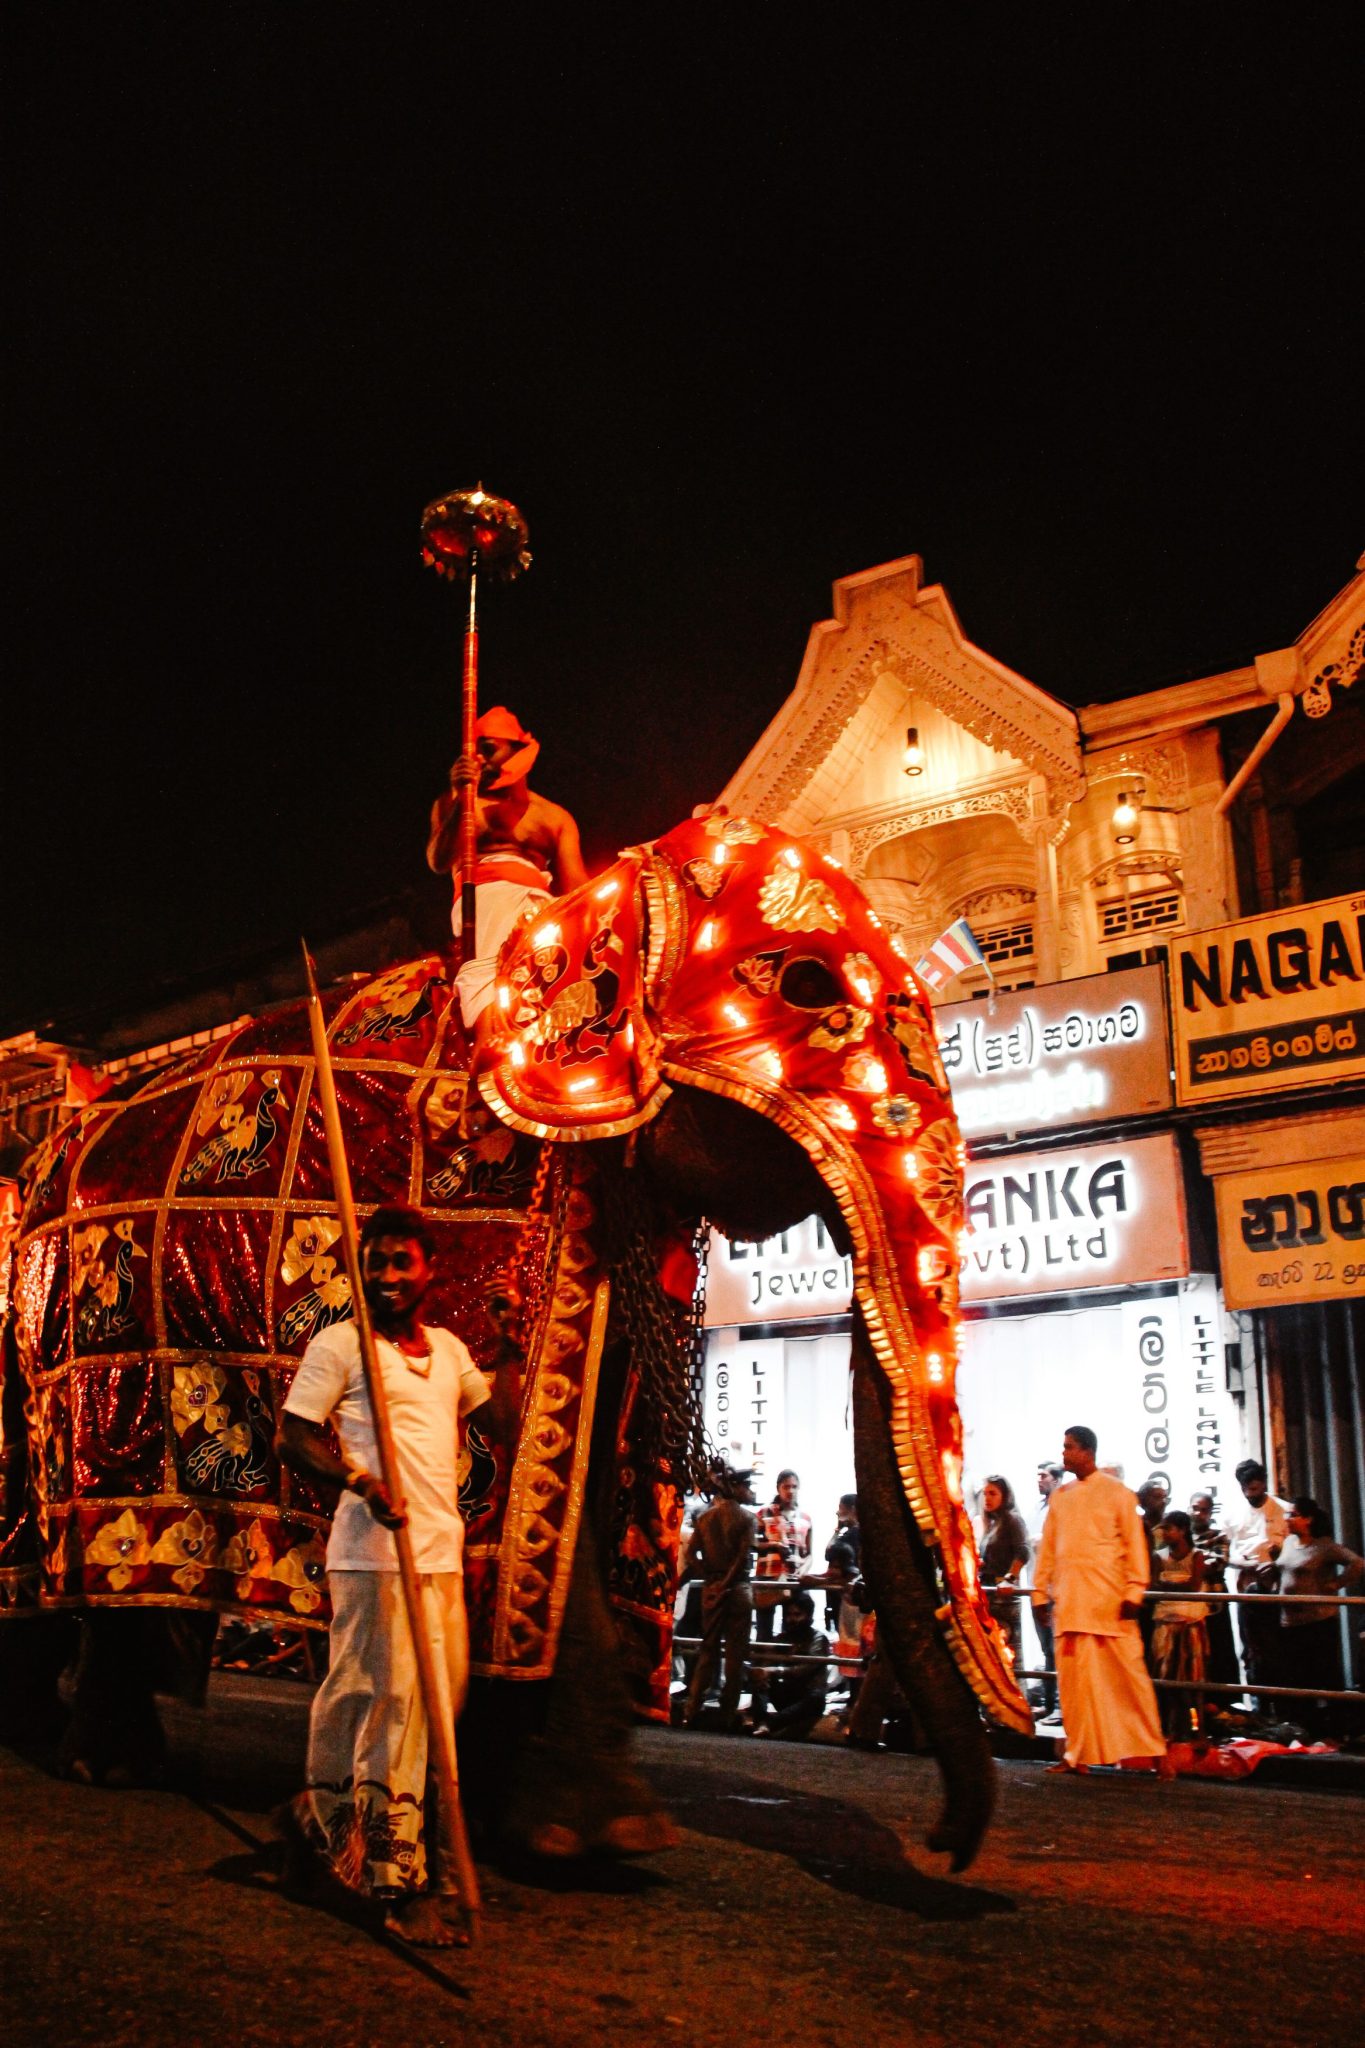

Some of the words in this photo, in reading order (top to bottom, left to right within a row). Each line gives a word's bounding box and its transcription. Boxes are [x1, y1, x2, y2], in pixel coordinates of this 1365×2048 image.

[1044, 1005, 1138, 1051] සමාගම
[1045, 1227, 1107, 1265] Ltd
[1313, 1261, 1335, 1281] 22
[1191, 1315, 1215, 1394] LITTLE
[1196, 1407, 1222, 1473] LANKA
